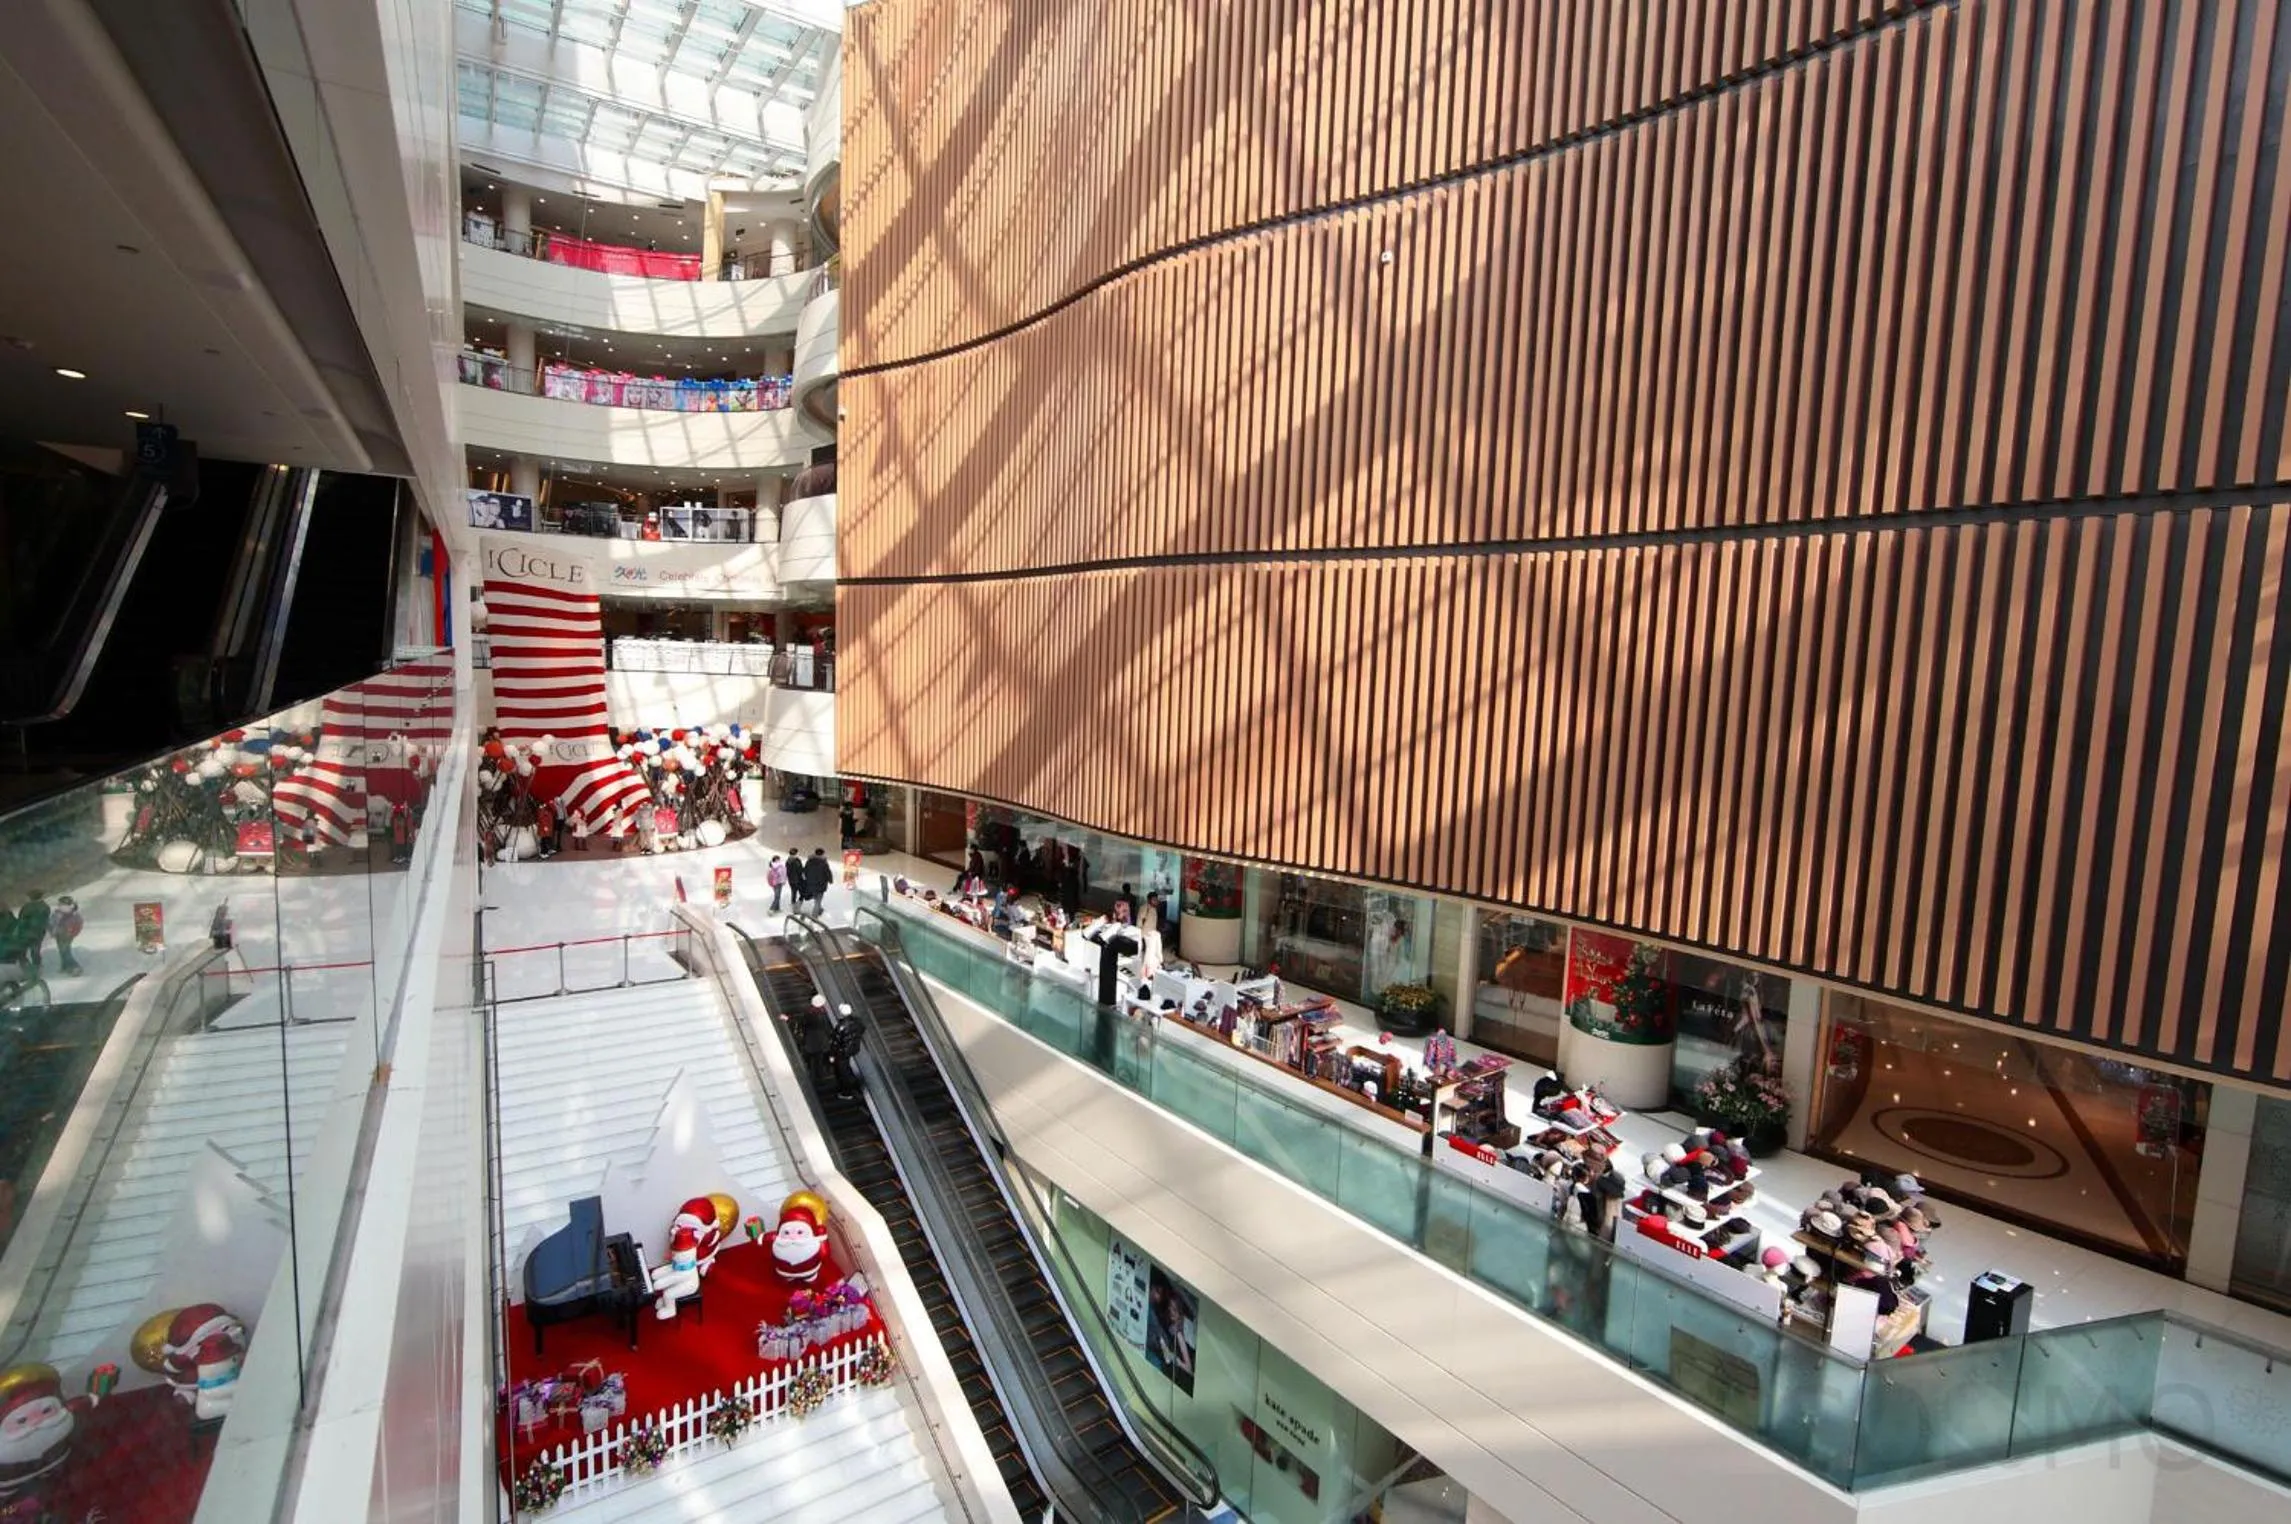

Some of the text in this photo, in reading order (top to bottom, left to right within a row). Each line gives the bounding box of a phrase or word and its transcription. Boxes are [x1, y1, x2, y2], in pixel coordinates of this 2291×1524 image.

[488, 547, 585, 583] ICICLE
[1676, 1240, 1698, 1257] ELLE
[1264, 1392, 1320, 1444] kate spade
